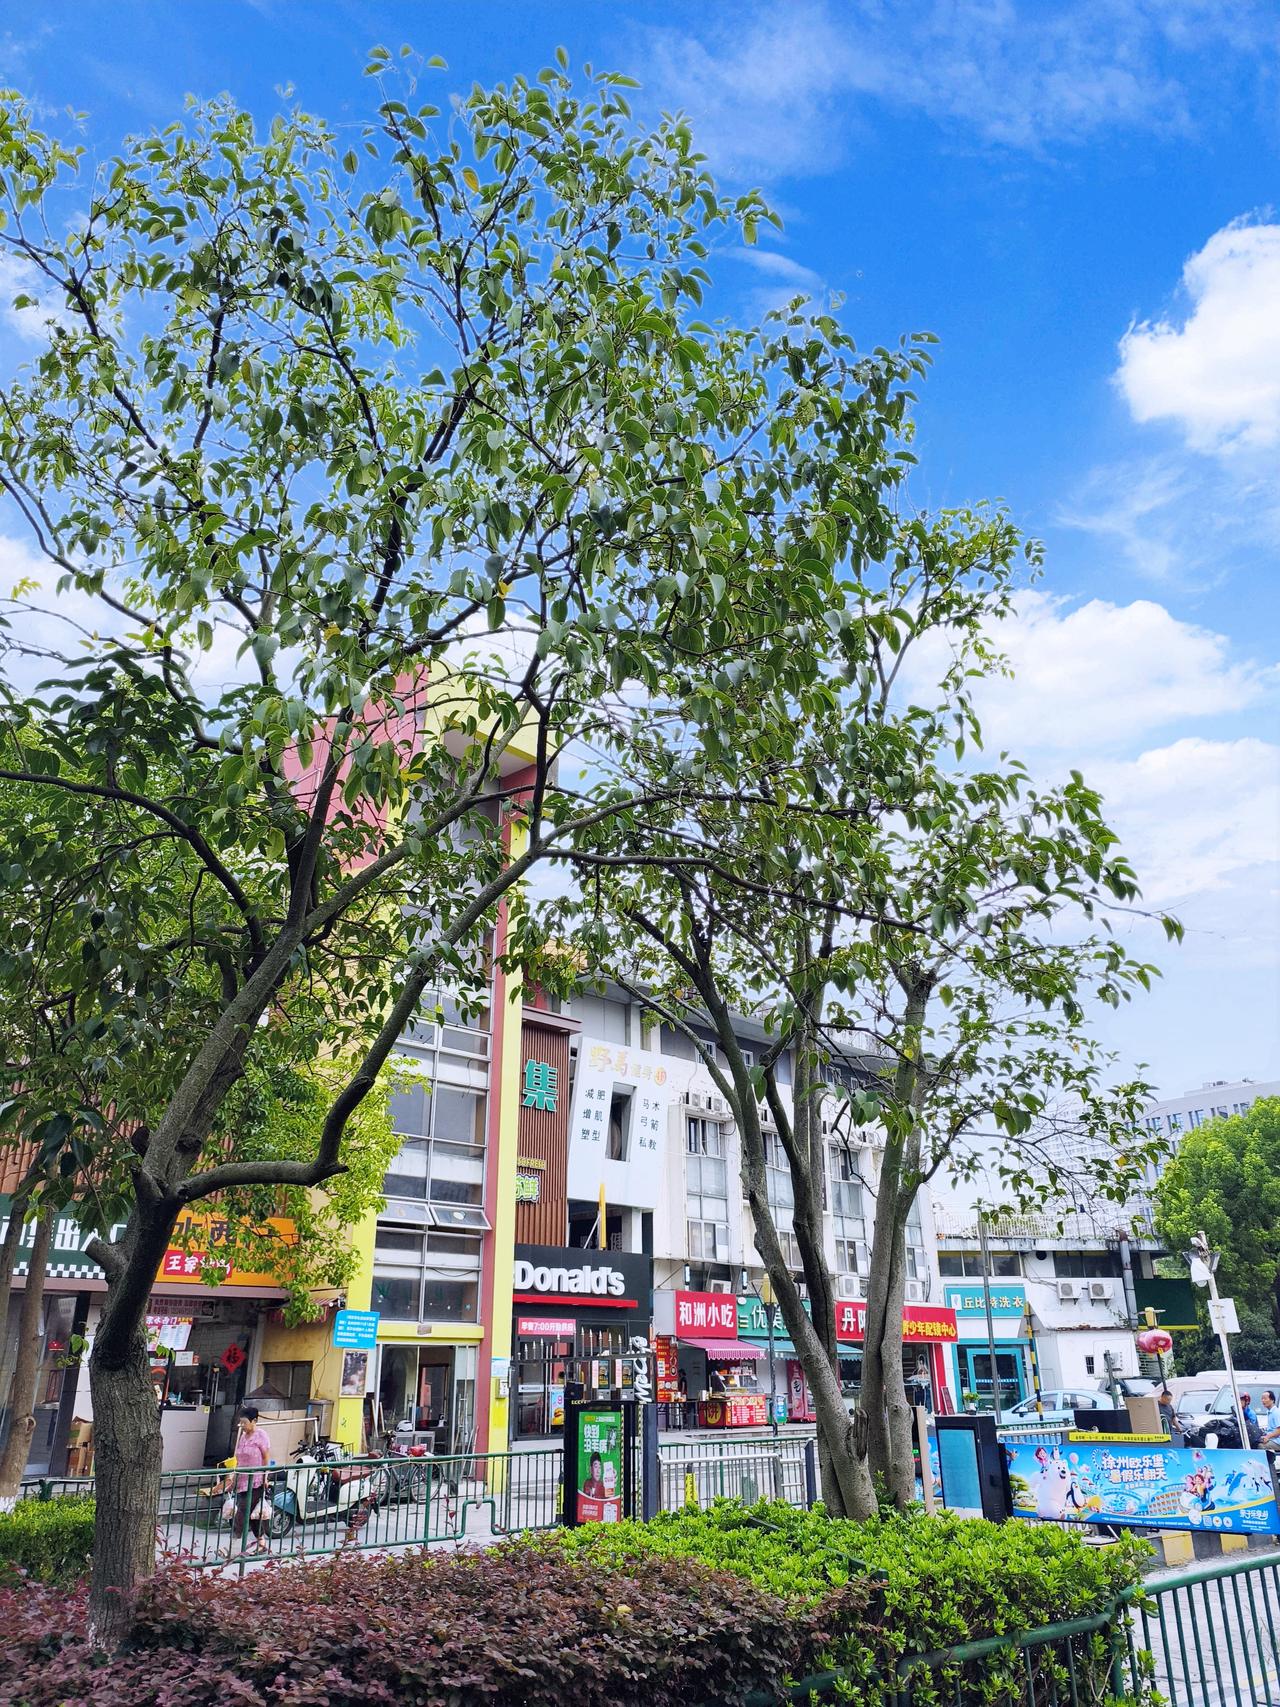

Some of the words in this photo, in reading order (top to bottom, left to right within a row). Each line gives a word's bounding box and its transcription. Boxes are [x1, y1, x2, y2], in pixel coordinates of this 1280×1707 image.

[523, 1058, 559, 1112] 集
[585, 1088, 605, 1100] 减肥
[641, 1116, 659, 1131] 弓箭
[580, 1128, 601, 1141] 塑型
[639, 1136, 657, 1151] 私教
[513, 1260, 625, 1296] Donald's
[679, 1301, 734, 1328] 和洲小吃
[1102, 1453, 1164, 1470] 徐州欧乐堡
[1109, 1467, 1168, 1483] 暑假乐翻天
